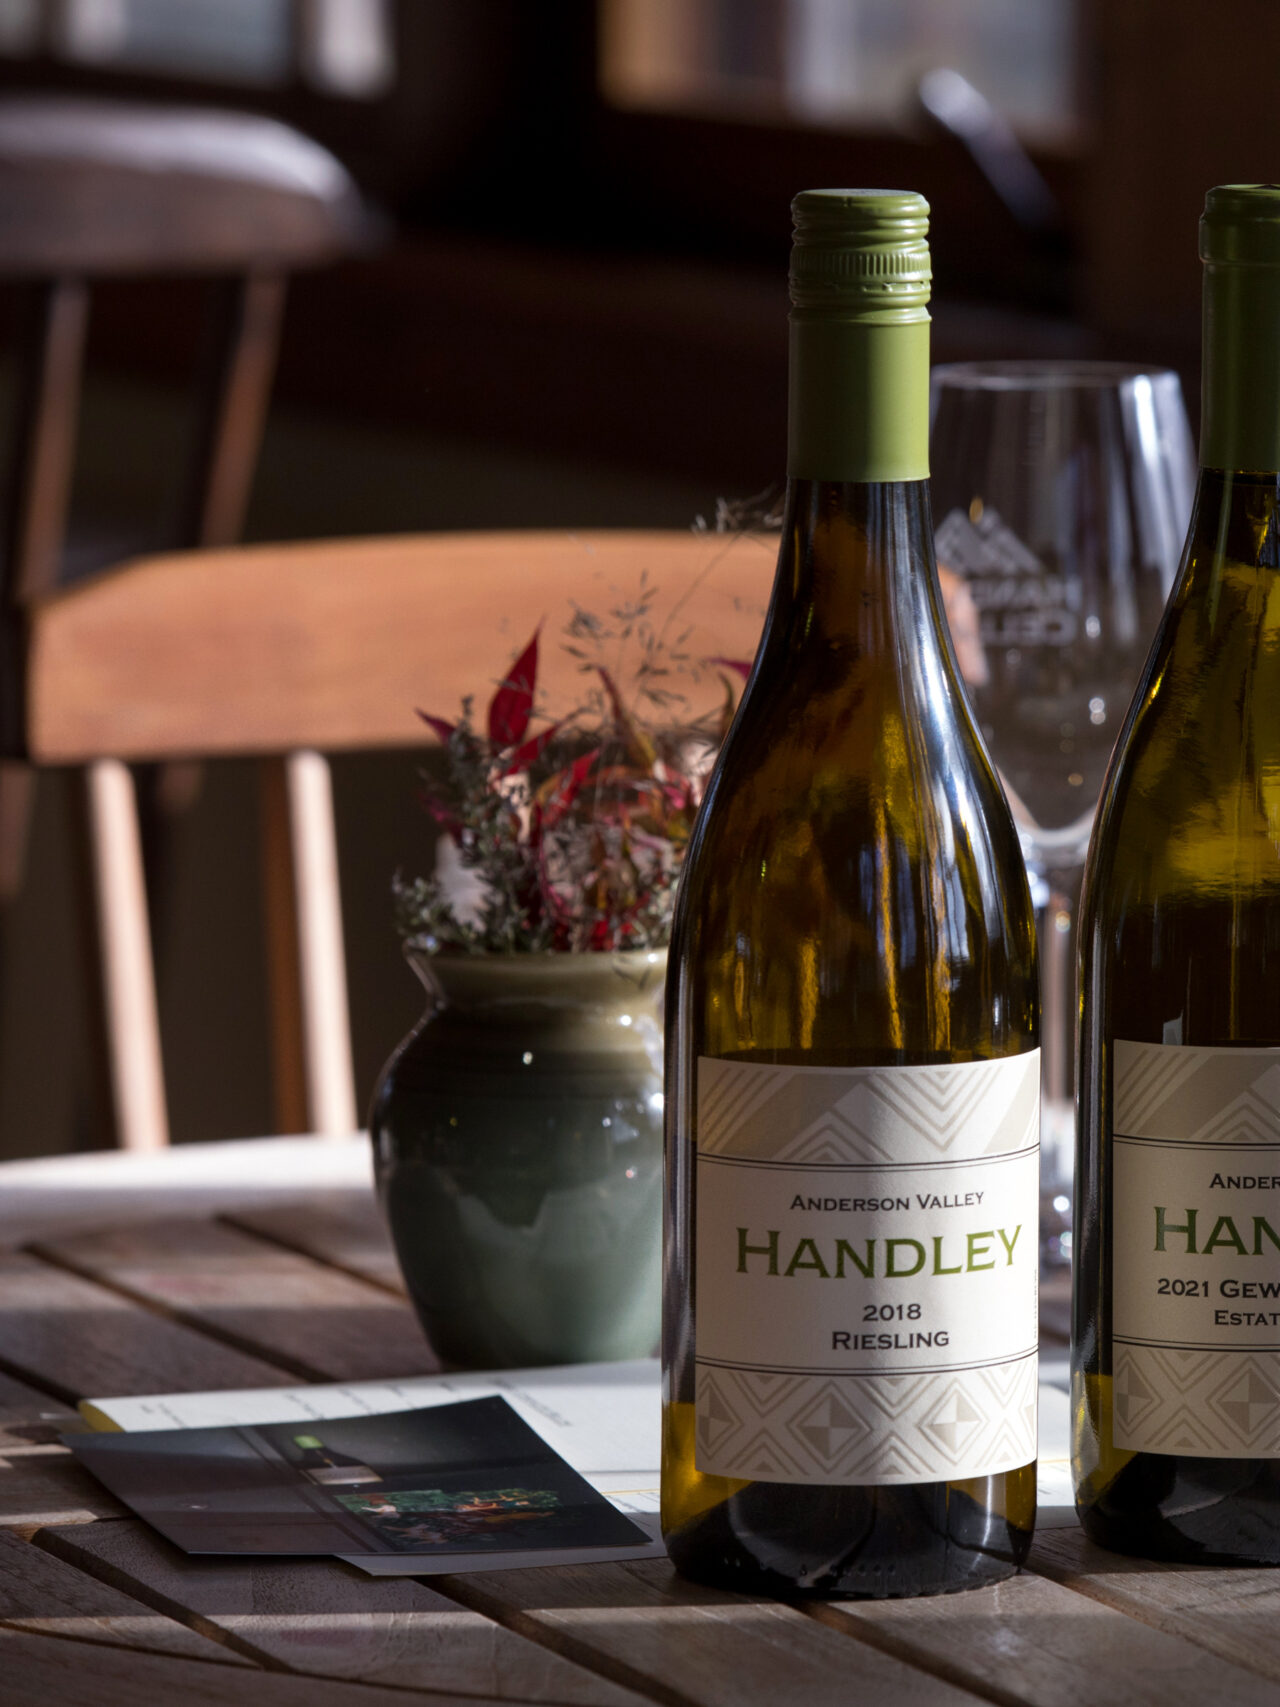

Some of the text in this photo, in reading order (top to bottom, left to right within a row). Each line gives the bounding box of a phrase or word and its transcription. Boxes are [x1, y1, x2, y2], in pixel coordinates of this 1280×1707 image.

[789, 1191, 985, 1212] ANDERSON VALLEY
[735, 1224, 1023, 1279] HANDLEY
[1157, 1276, 1210, 1298] 2021
[862, 1303, 922, 1322] 2018
[831, 1330, 950, 1351] RIESLING
